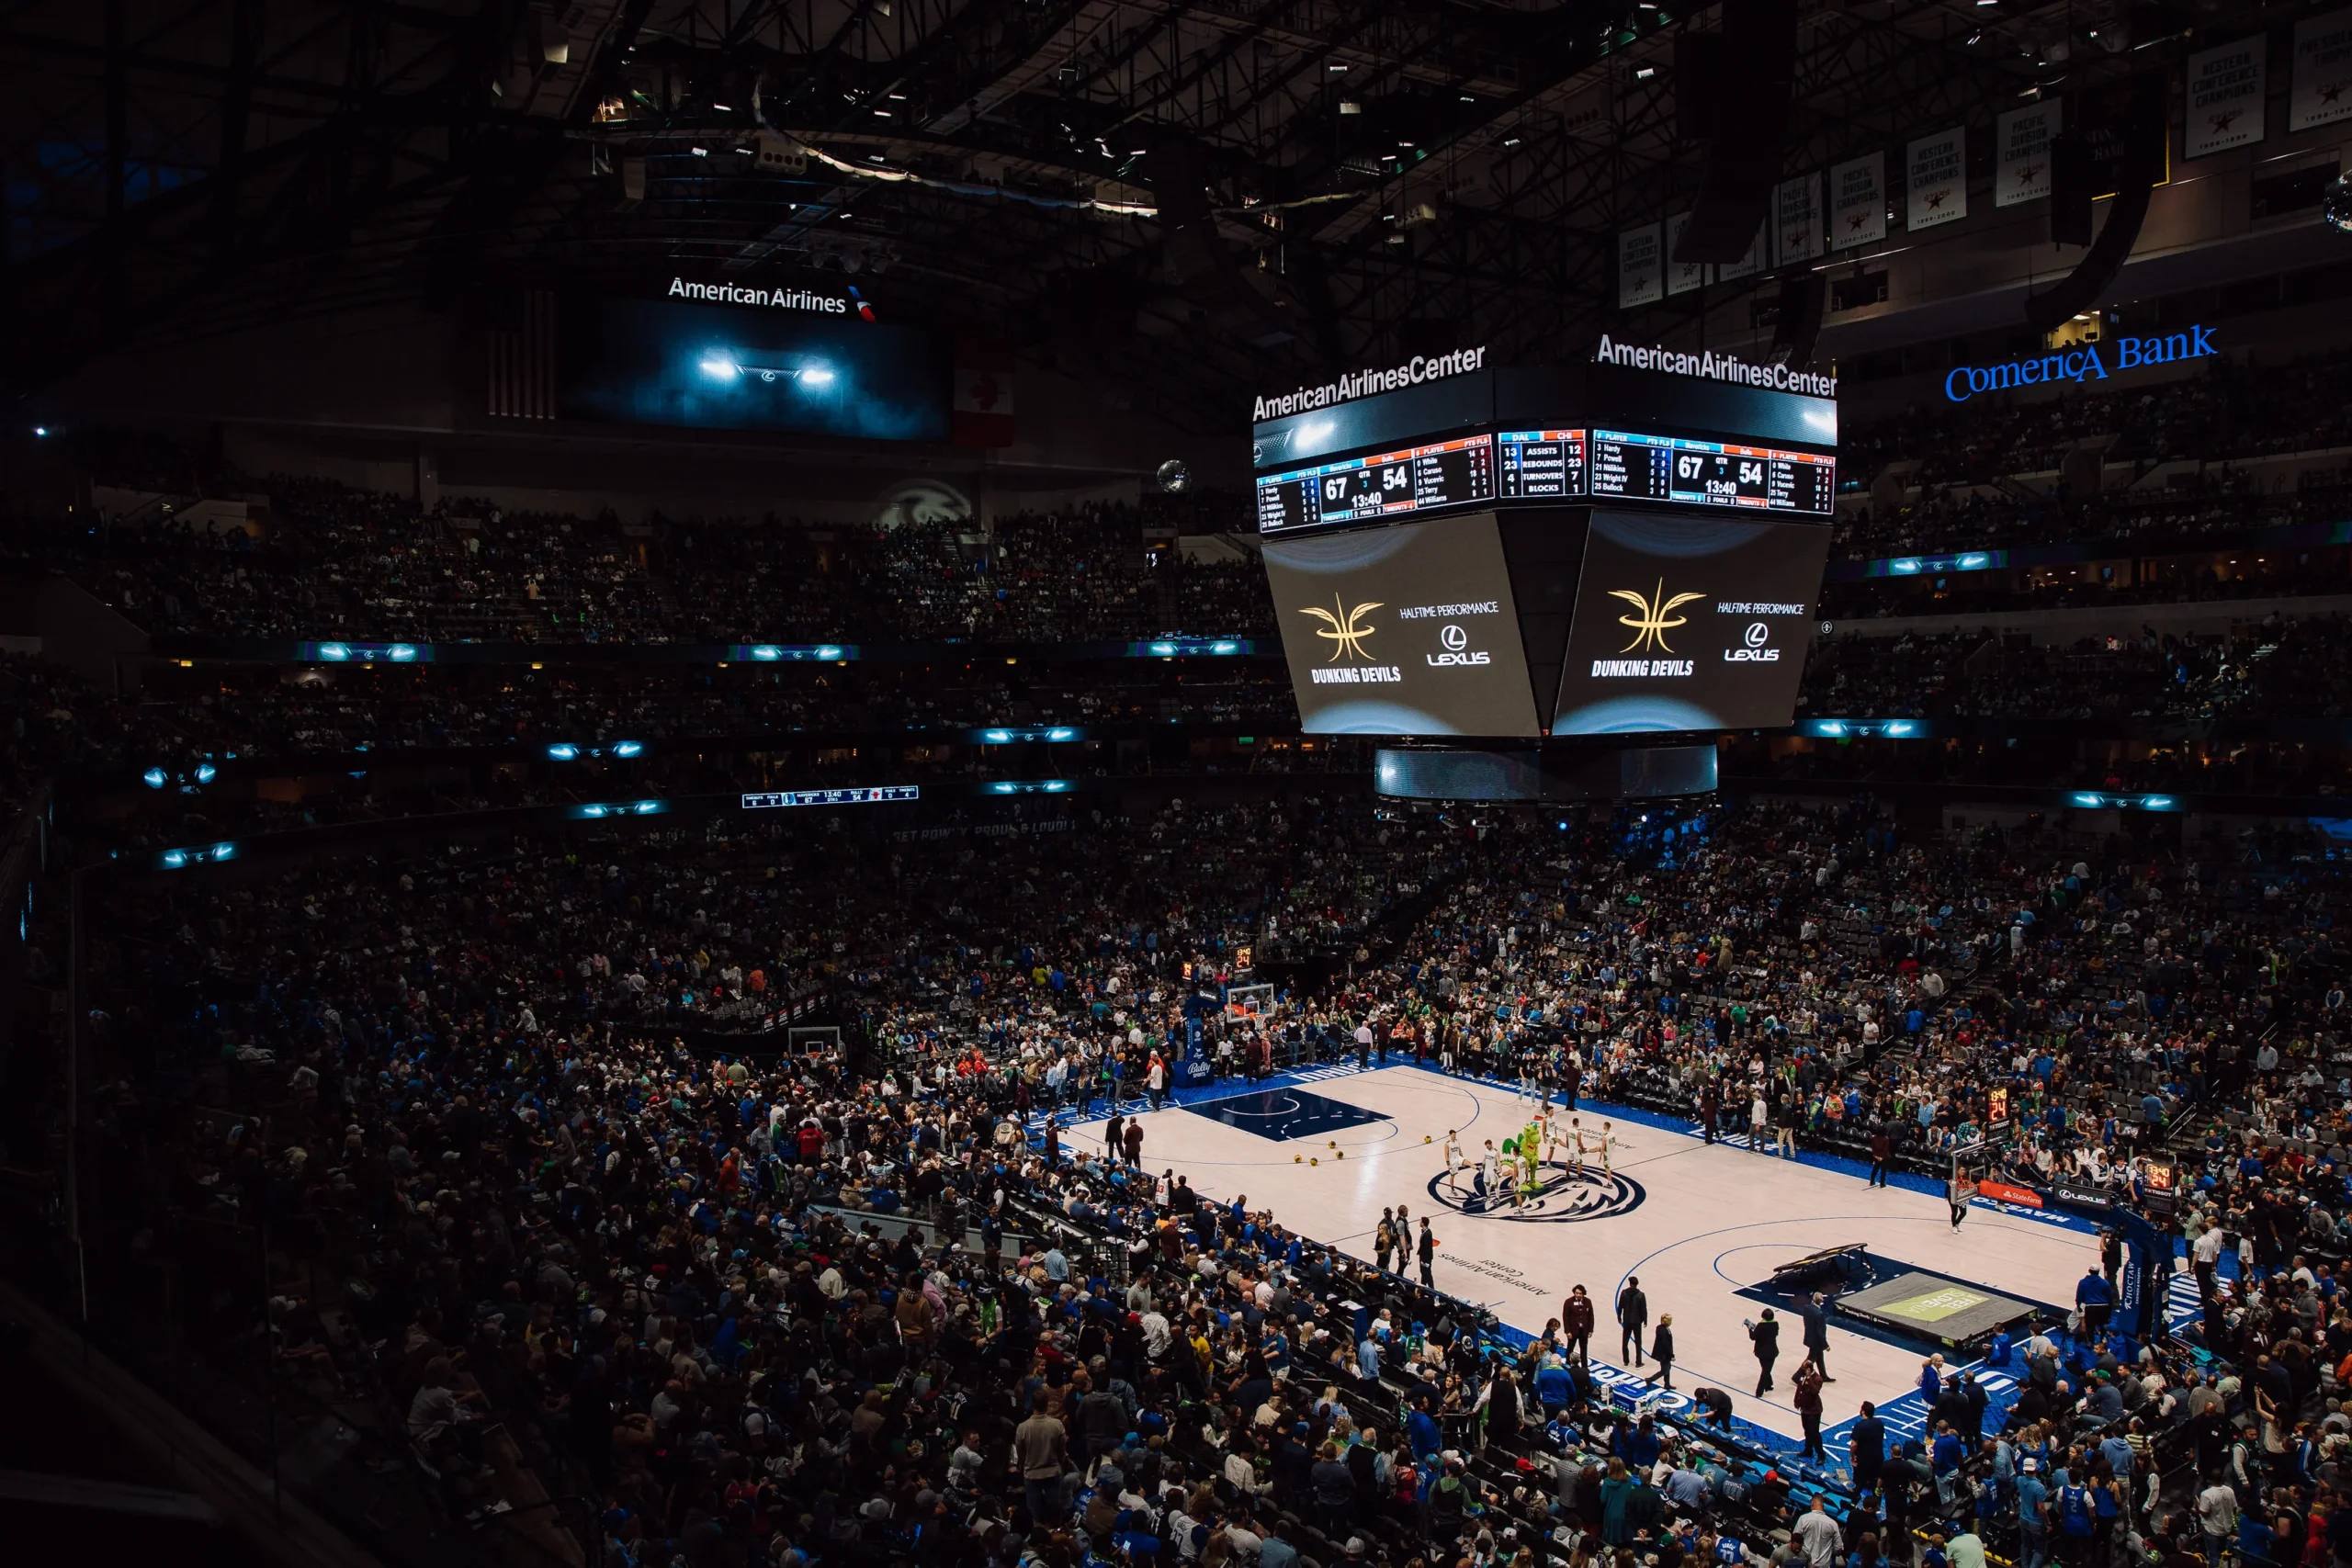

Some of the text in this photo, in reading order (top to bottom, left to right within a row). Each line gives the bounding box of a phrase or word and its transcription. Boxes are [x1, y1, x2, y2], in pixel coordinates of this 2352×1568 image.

[669, 277, 846, 313] American Airlines
[2116, 324, 2219, 369] Bank
[1557, 432, 1572, 440] CHI
[1423, 446, 1444, 455] PLAYER
[1504, 446, 1581, 457] 13 ASSISTS 12
[1604, 444, 1621, 454] Hardy
[1422, 457, 1438, 466] White
[1504, 461, 1518, 469] 23
[1567, 458, 1582, 468] 23
[1597, 453, 1600, 461] 7
[1603, 454, 1623, 463] Powell
[1423, 467, 1442, 476] Caruso
[1481, 458, 1485, 467] 2
[1595, 463, 1602, 471] 21
[1650, 468, 1655, 476] 5
[1679, 456, 1703, 479] 67
[1719, 467, 1724, 475] 3
[1777, 462, 1791, 470] White
[1359, 470, 1371, 479] QTR
[1383, 466, 1408, 491] 54
[1424, 475, 1444, 485] Vucevic
[1482, 468, 1486, 476] 0
[1507, 471, 1578, 482] 4 TURNOVERS 7
[1602, 473, 1621, 483] Wright
[1650, 478, 1654, 486] 0
[1661, 479, 1665, 487] 0
[1739, 462, 1762, 485] 54
[1326, 477, 1348, 501] 67
[1425, 486, 1438, 494] Terry
[1482, 478, 1487, 486] 2
[1510, 486, 1514, 495] 1
[1573, 484, 1578, 492] 1
[1602, 482, 1623, 491] Bullock
[1649, 487, 1654, 495] 3
[1705, 479, 1736, 495] 13:40
[1351, 491, 1382, 508] 13:40
[1425, 495, 1447, 504] Williams
[1400, 602, 1498, 620] HALFTIME PERFORMANCE
[1717, 602, 1804, 615] HALFTIME PERFORMANCE
[1427, 651, 1491, 666] LEXUS
[1724, 649, 1780, 661] LEXUS
[1311, 666, 1402, 684] DUNKING DEVILS
[1591, 660, 1694, 677] DUNKING DEVILS
[1237, 956, 1250, 967] 24
[1188, 1062, 1210, 1076] Bally
[1991, 1101, 2006, 1120] 24
[2152, 1175, 2166, 1187] 24
[2071, 1193, 2107, 1204] LEXUS
[1438, 1252, 1551, 1296] American Airlines
[1478, 1259, 1523, 1278] Center
[2124, 1261, 2134, 1305] CHOCTAW
